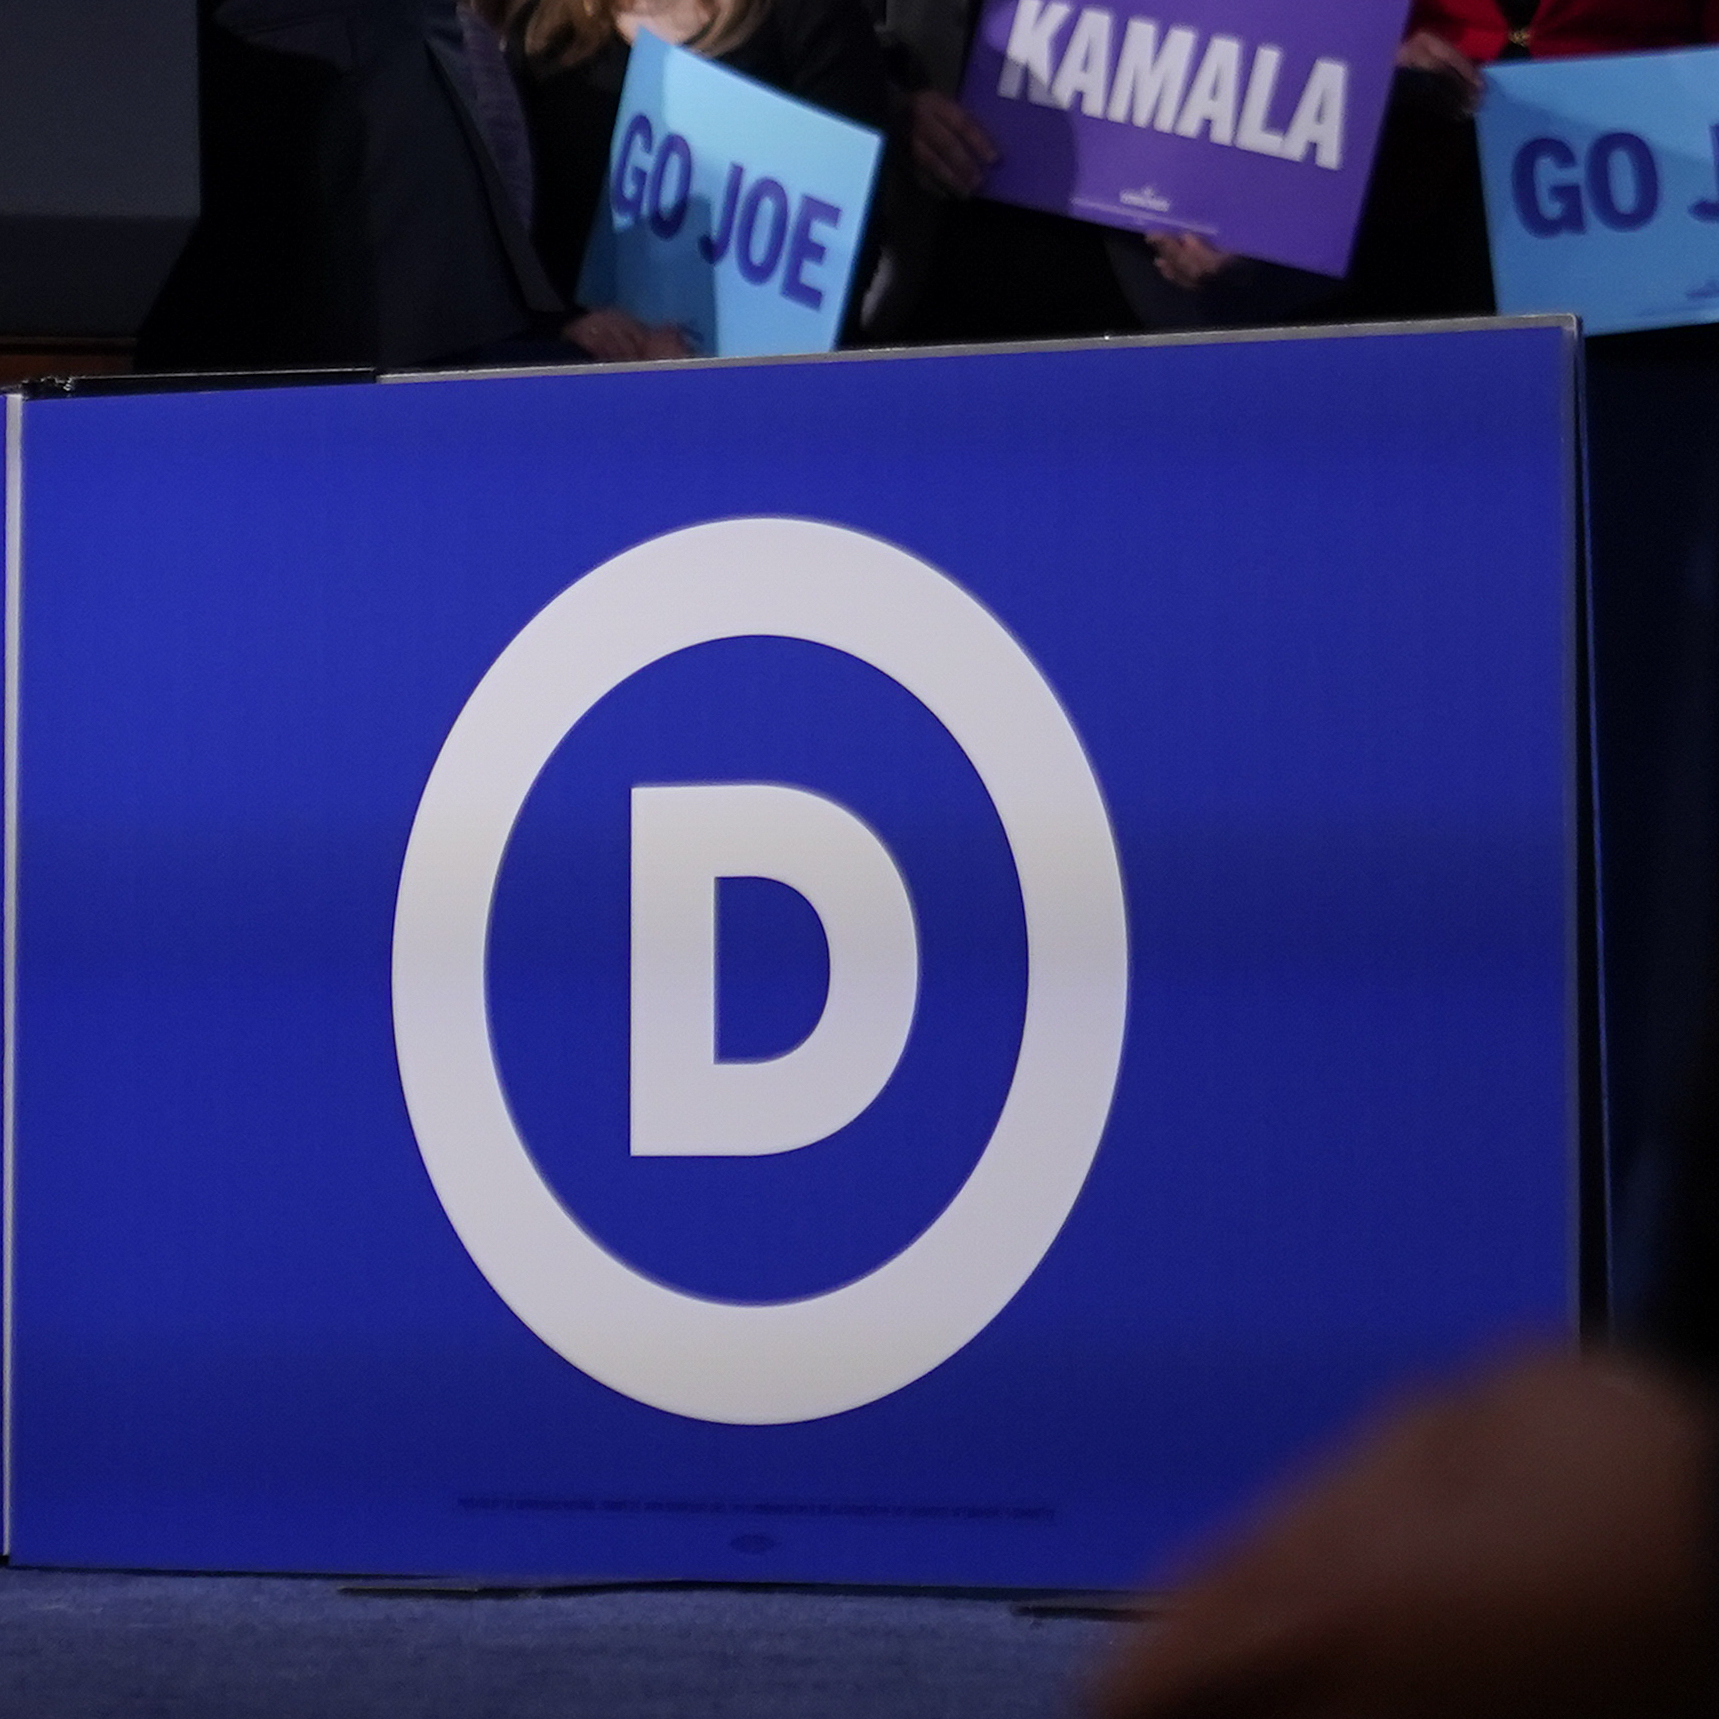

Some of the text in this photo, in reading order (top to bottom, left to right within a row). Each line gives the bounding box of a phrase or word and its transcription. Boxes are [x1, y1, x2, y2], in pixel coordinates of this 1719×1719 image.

[610, 113, 841, 311] GO JOE
[1511, 131, 1660, 239] GO
[629, 783, 920, 1157] D
